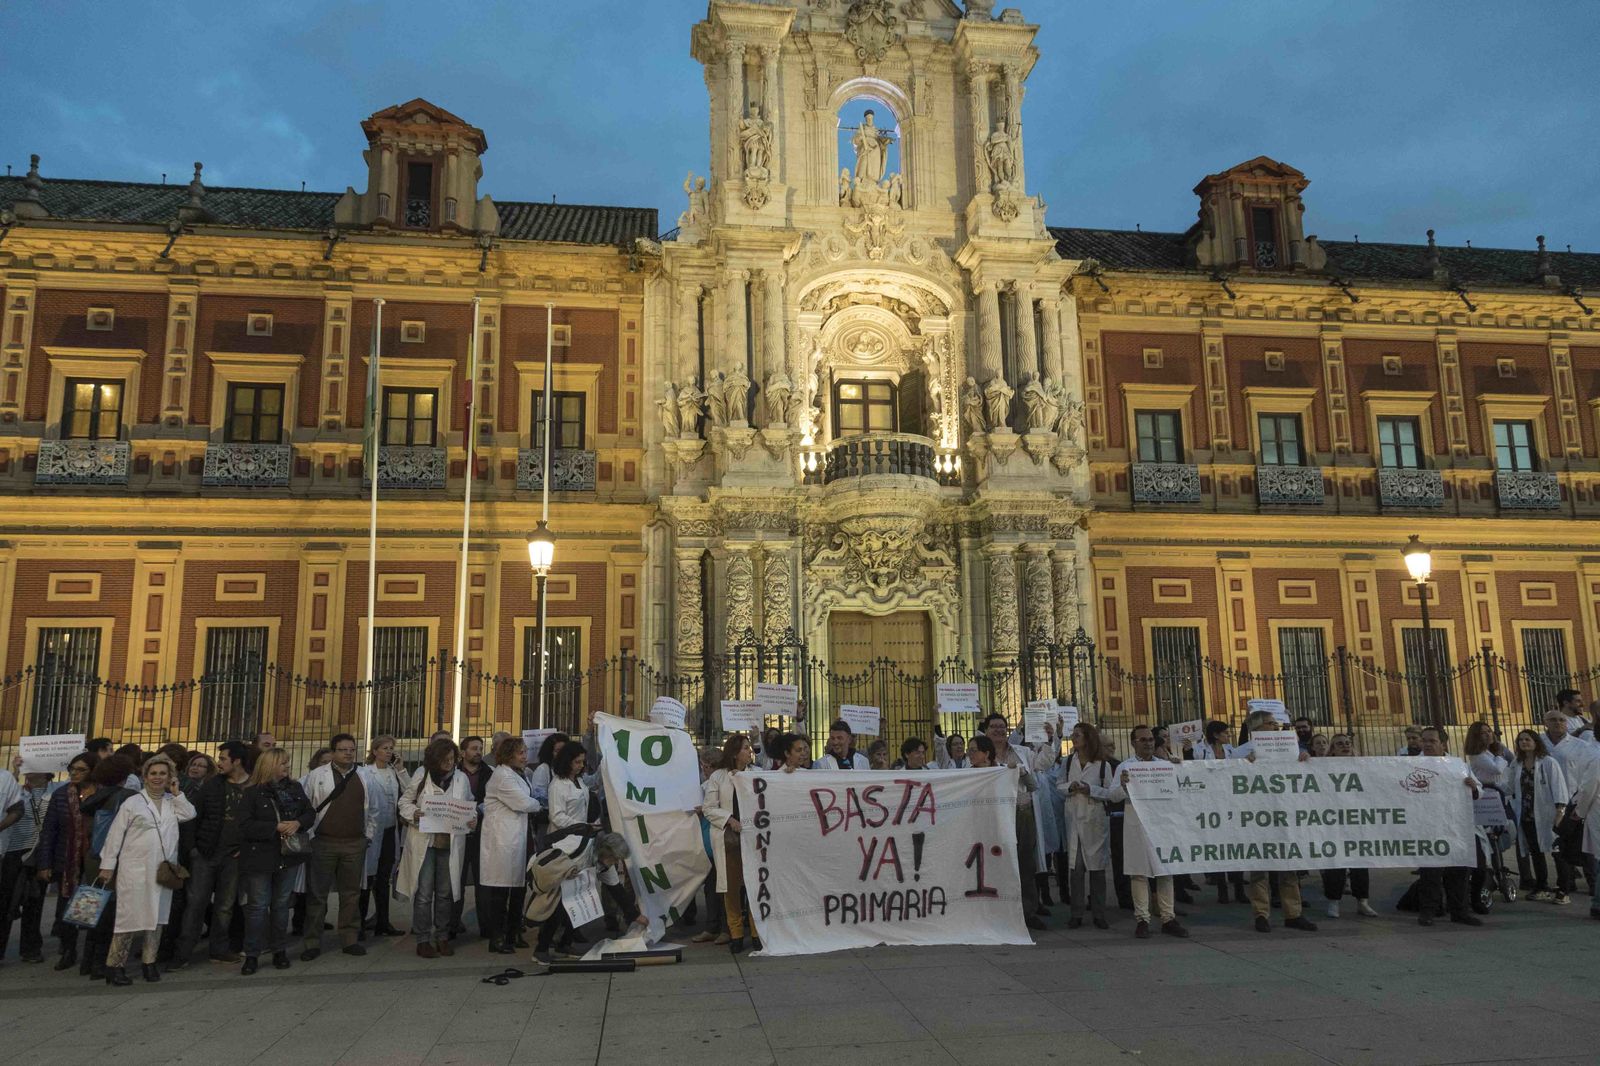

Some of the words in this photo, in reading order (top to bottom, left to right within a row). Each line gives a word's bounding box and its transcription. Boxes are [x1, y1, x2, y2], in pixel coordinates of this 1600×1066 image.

[612, 728, 674, 767] 10
[1232, 773, 1321, 795] BASTA
[1328, 773, 1364, 793] YA
[809, 779, 937, 837] BASTA
[1240, 811, 1288, 828] POR
[1295, 808, 1407, 827] PACIENTE
[857, 831, 926, 884] YA!
[1155, 846, 1184, 864] LA
[1190, 842, 1304, 862] PRIMARIA
[1309, 841, 1338, 859] LO
[1343, 840, 1451, 858] PRIMERO
[823, 886, 948, 926] PRIMARIA
